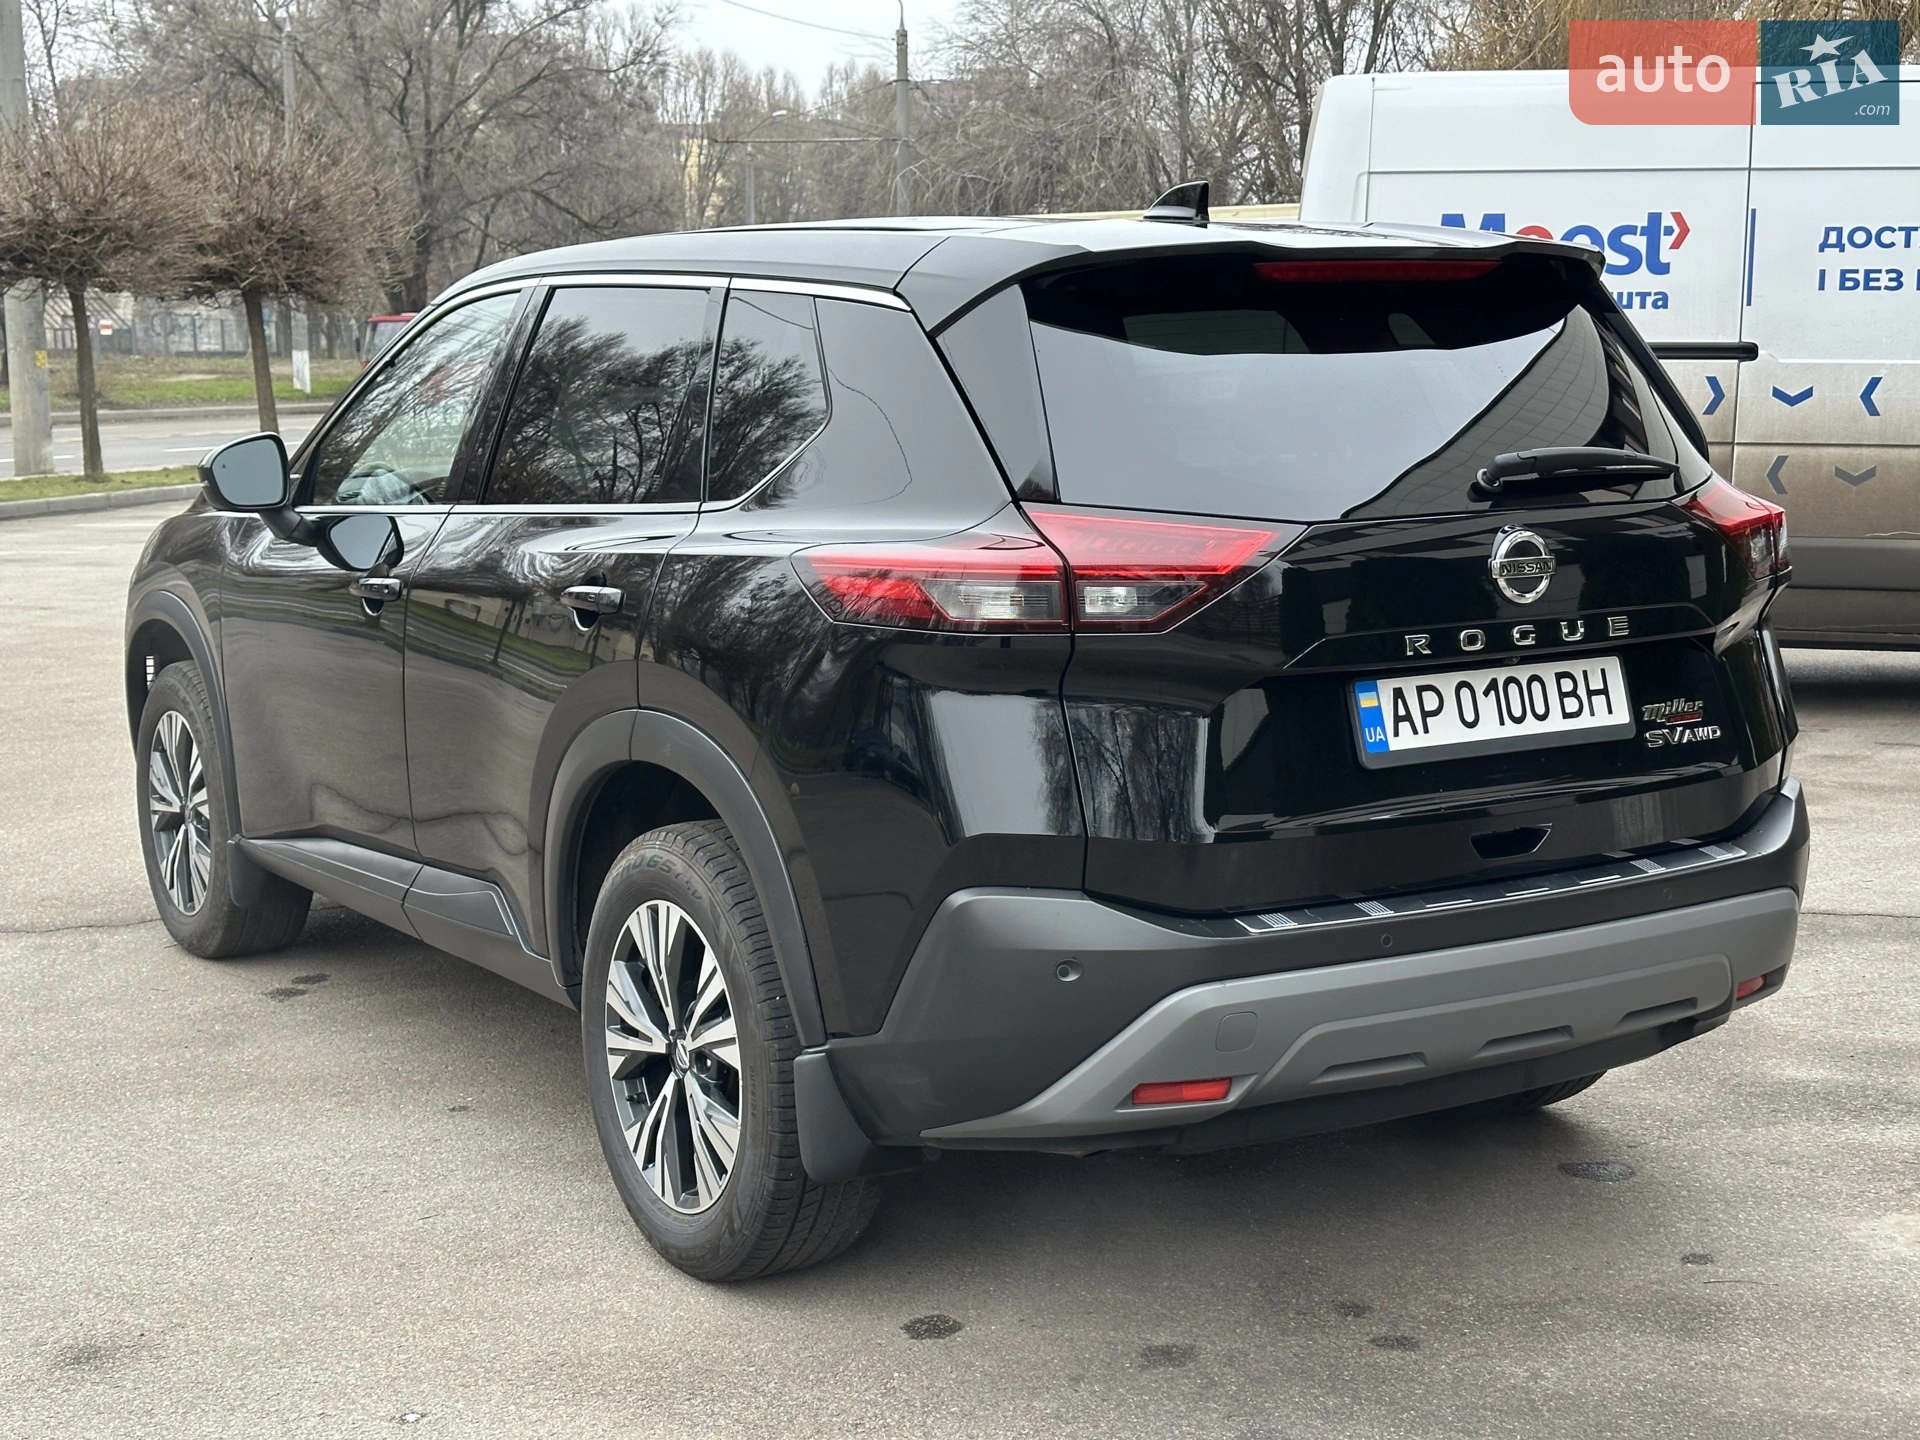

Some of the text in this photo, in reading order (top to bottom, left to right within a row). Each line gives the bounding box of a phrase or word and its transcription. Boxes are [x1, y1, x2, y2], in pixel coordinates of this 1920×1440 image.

[1818, 225, 1920, 253] ДОСТ
[1838, 268, 1904, 291] БЕЗ
[1500, 561, 1553, 575] NISSAN
[1404, 616, 1630, 656] ROGUE
[1392, 667, 1613, 737] AP 0100 BH
[1365, 726, 1386, 743] UA
